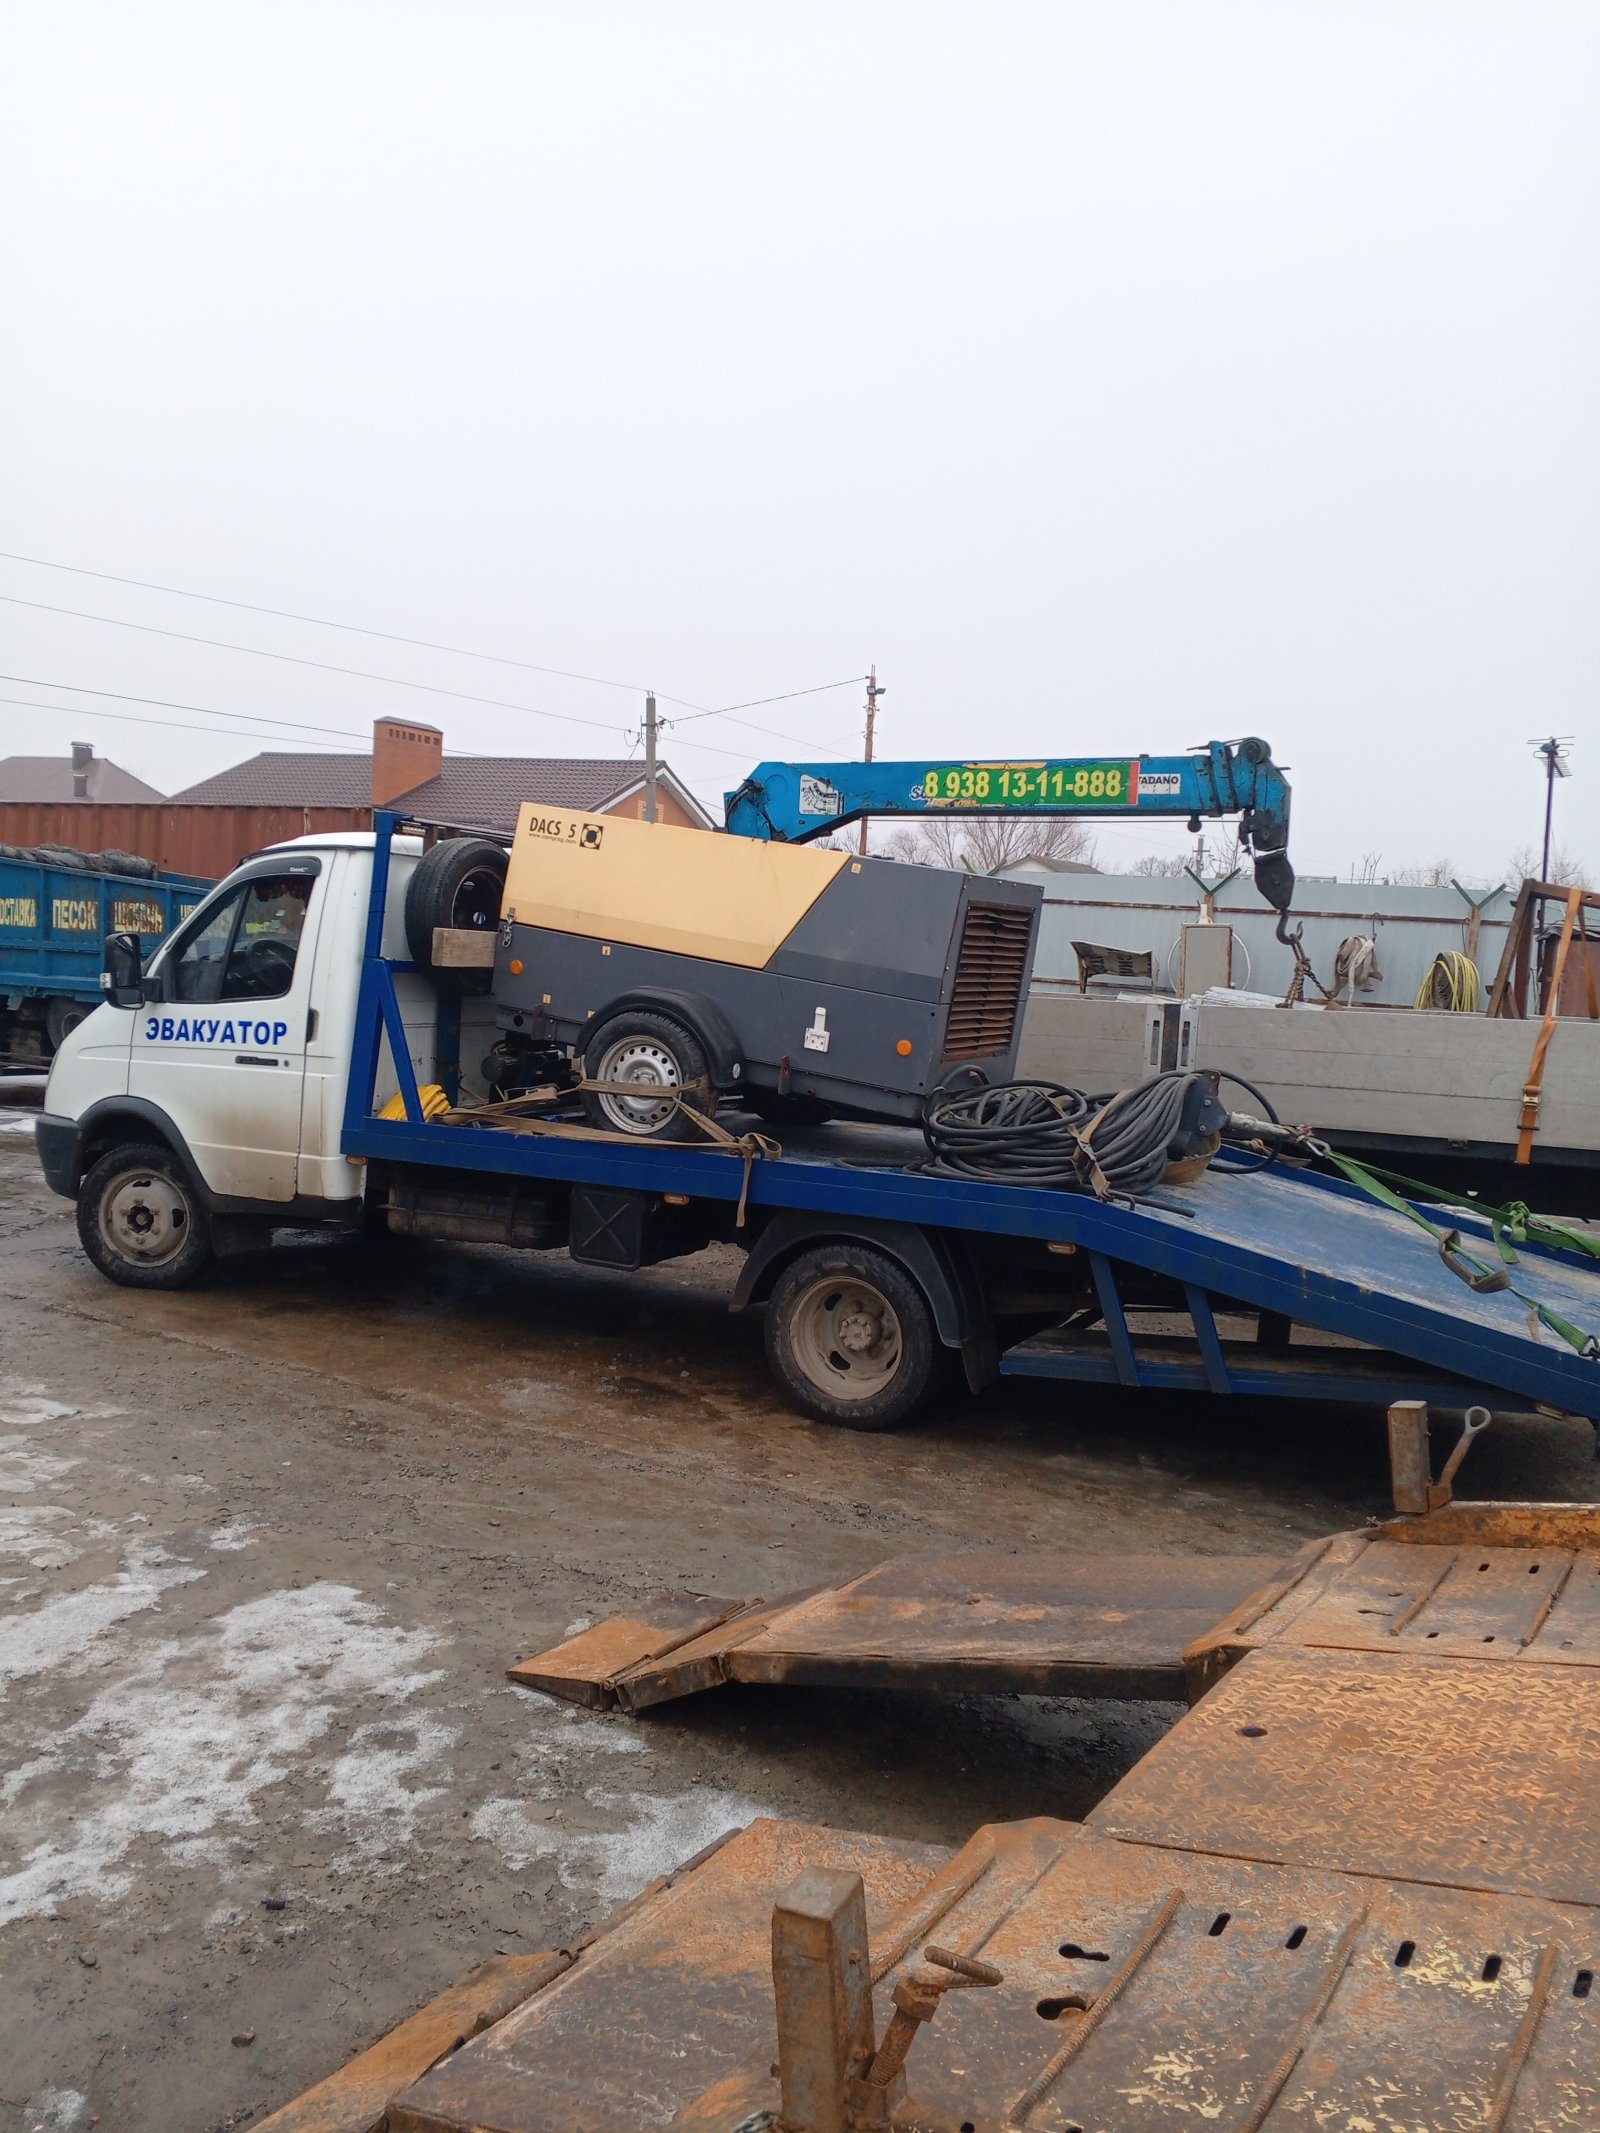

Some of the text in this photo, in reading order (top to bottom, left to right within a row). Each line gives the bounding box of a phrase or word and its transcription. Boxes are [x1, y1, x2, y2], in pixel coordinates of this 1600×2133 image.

[925, 772, 939, 798] 8
[946, 771, 990, 798] 938
[998, 769, 1122, 798] 13-11-888
[529, 817, 577, 838] DACS 5
[52, 899, 97, 930] ПЕСОК
[145, 1017, 288, 1046] ЭВАКУАТОР
